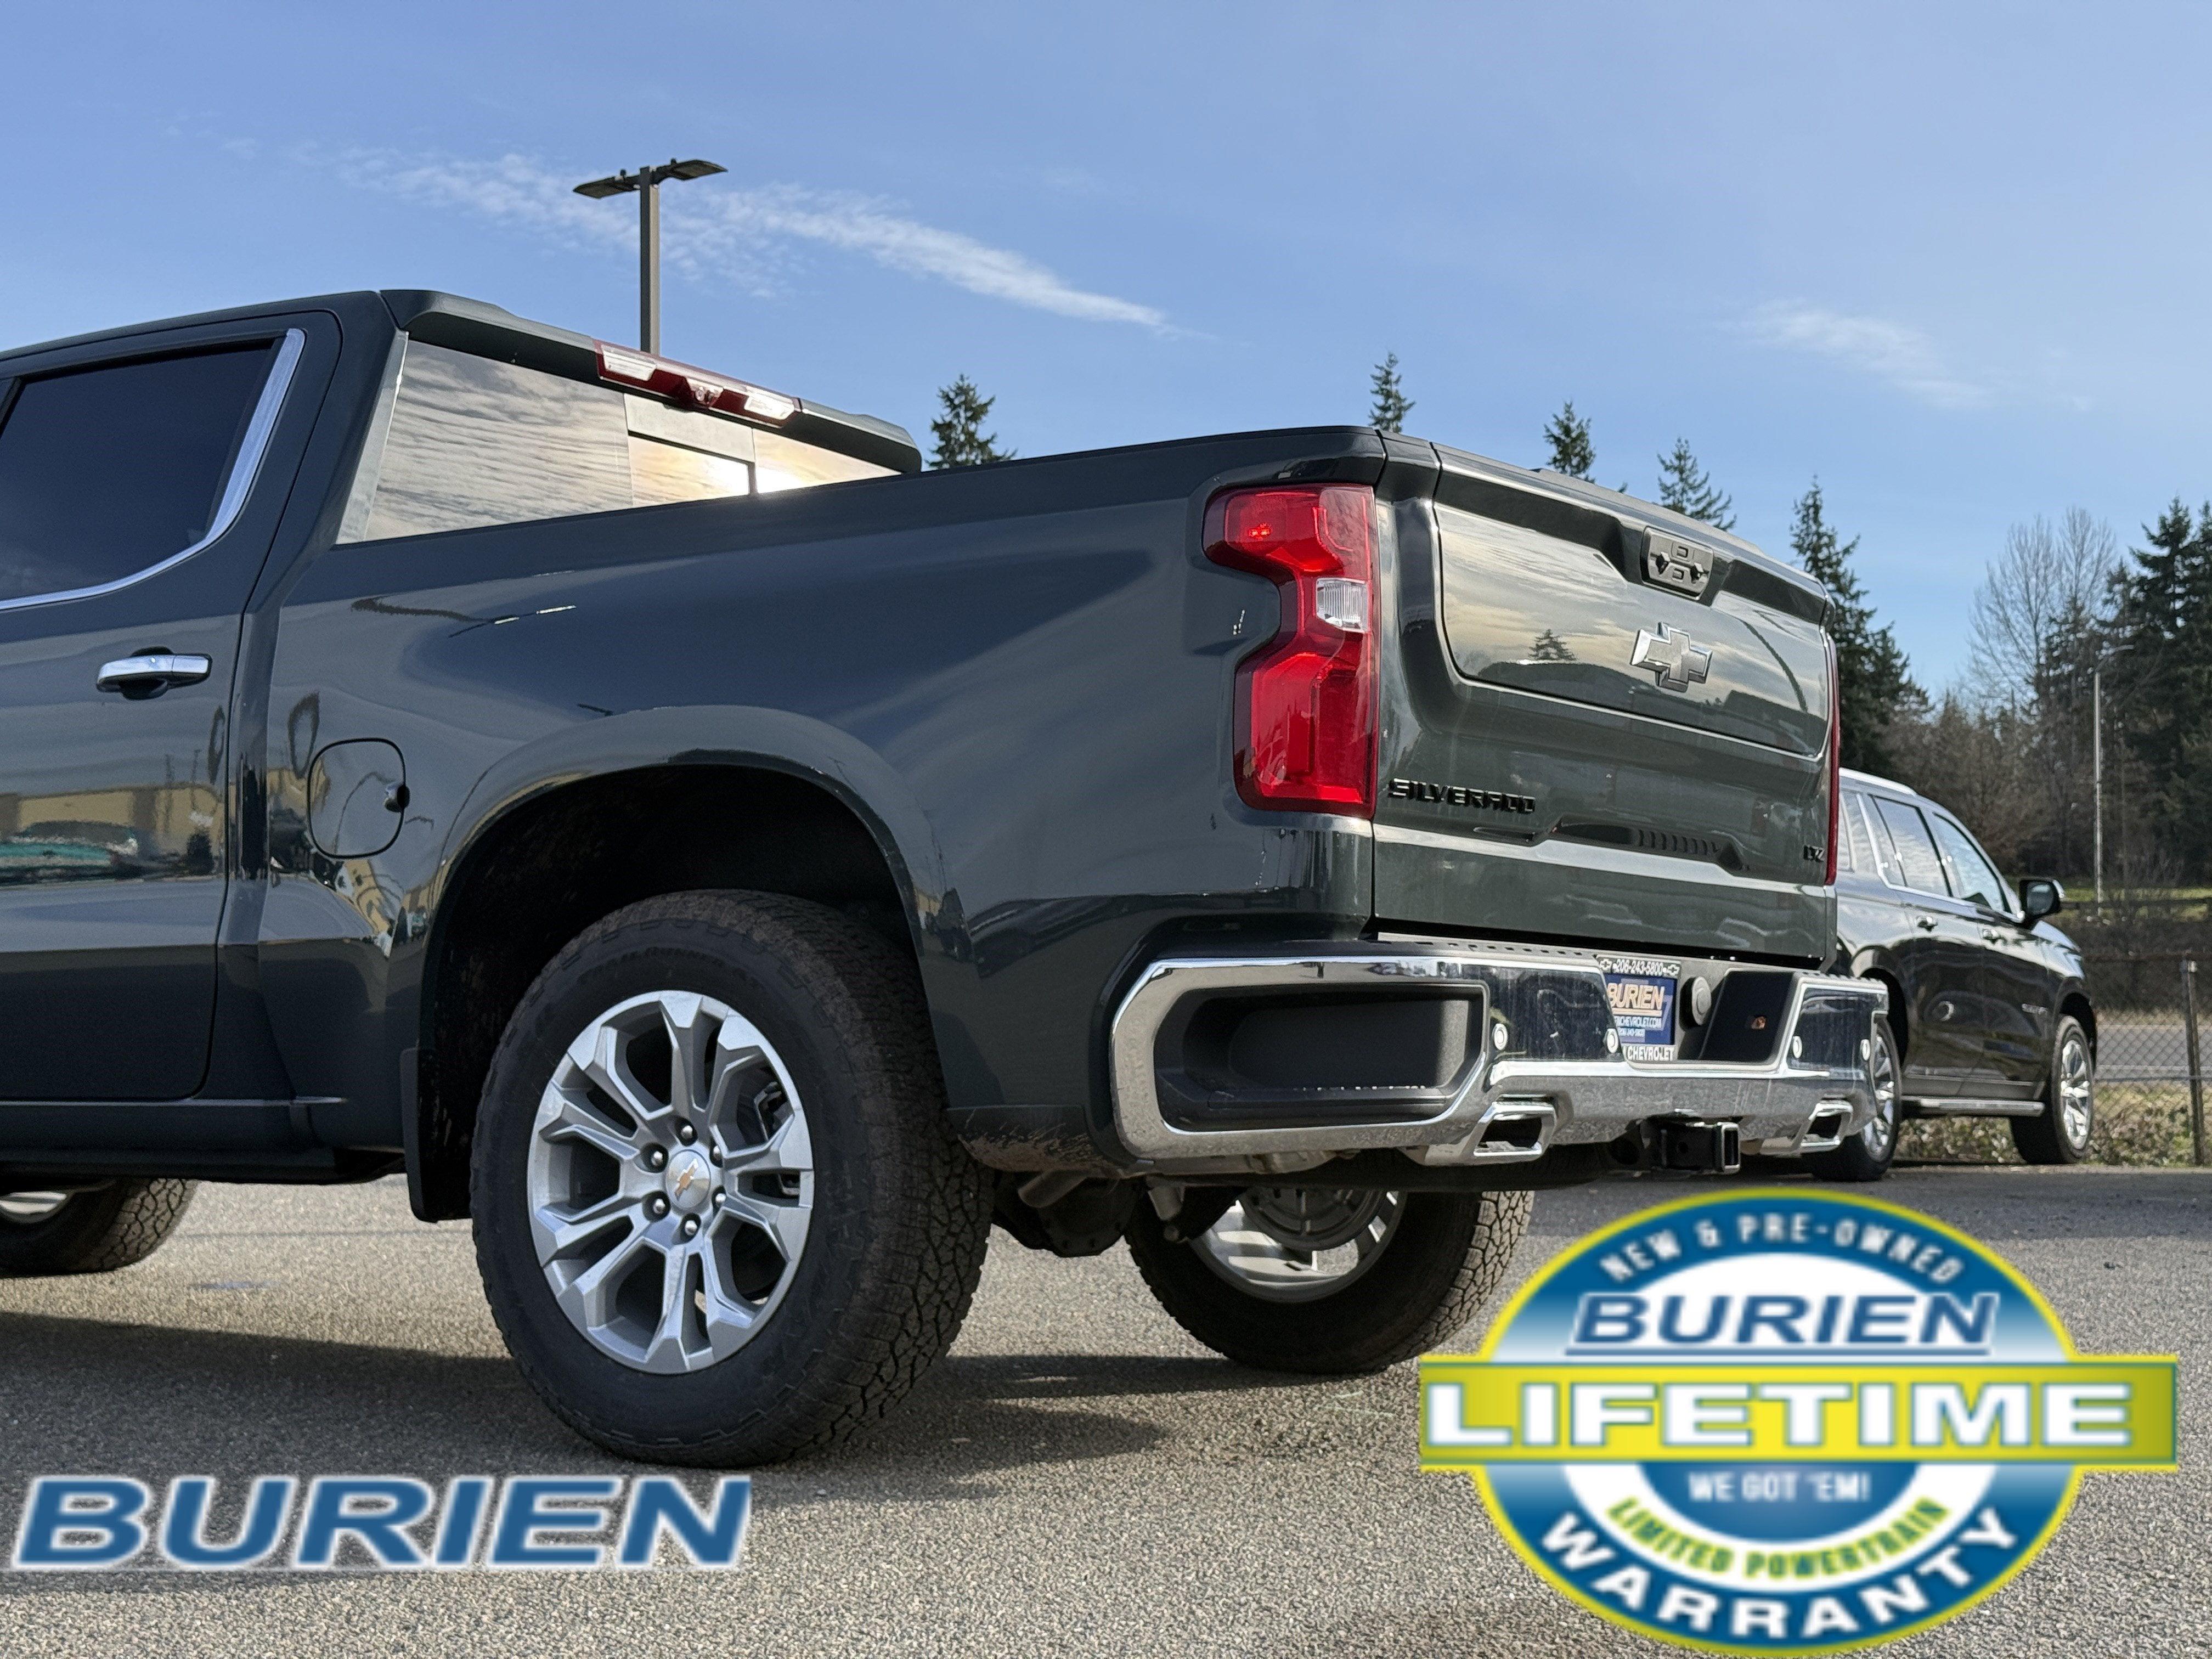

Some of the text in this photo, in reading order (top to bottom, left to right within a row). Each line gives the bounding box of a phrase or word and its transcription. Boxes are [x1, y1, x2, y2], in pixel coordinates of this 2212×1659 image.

[1387, 778, 1536, 814] SILVERADO
[1617, 959, 1664, 976] 206-243-5800
[1607, 983, 1664, 1010] BURIEN
[1627, 1045, 1675, 1062] CHEVROLET
